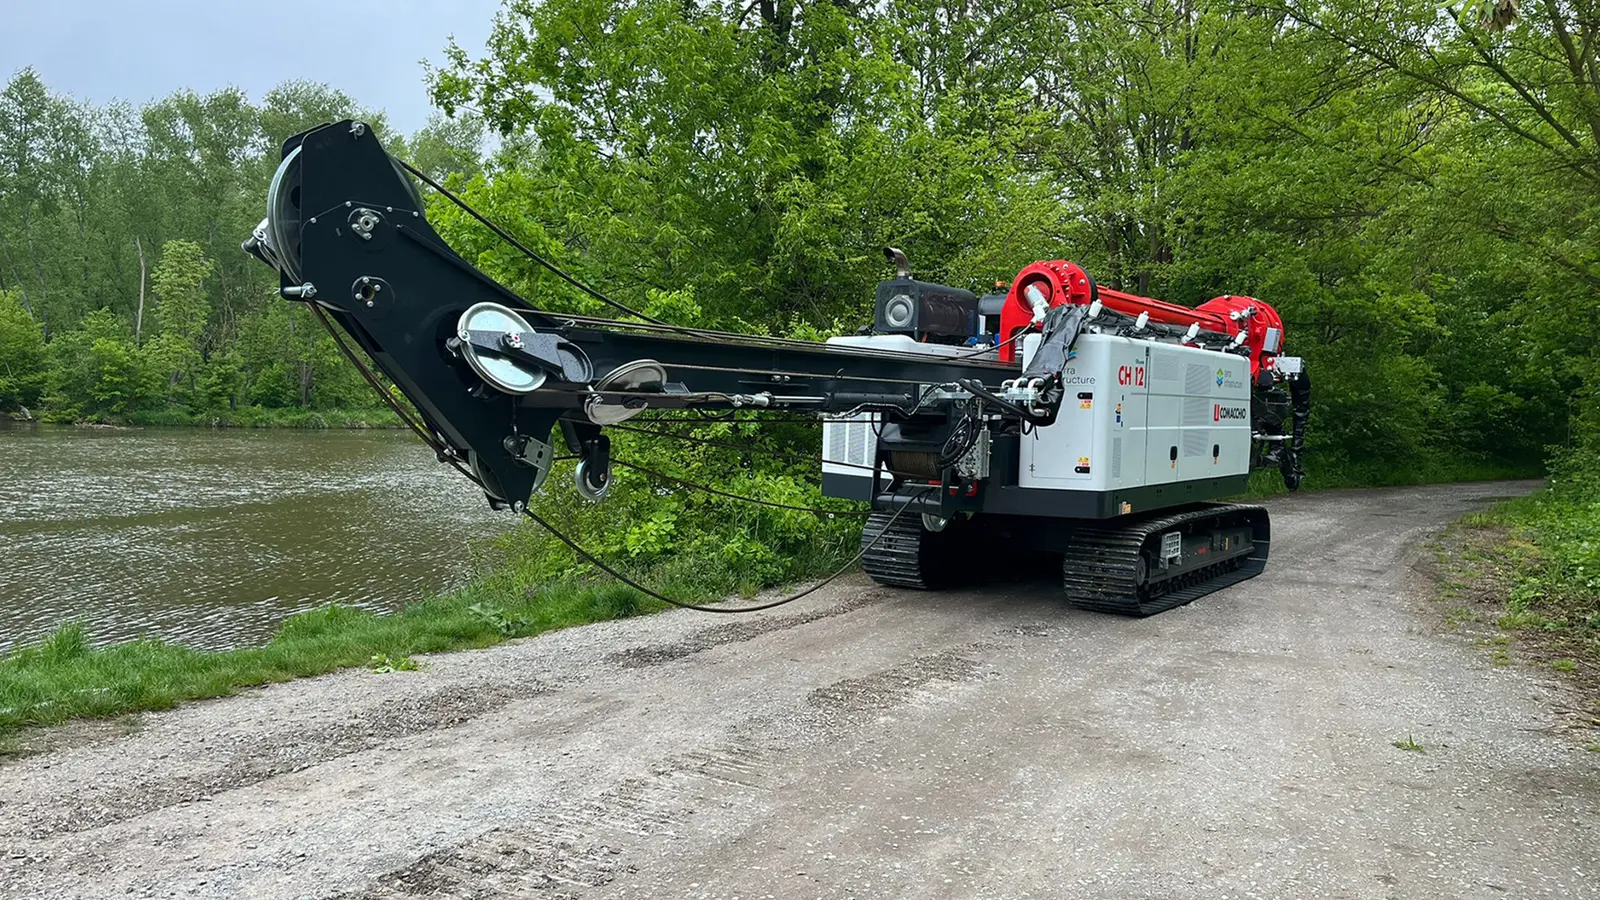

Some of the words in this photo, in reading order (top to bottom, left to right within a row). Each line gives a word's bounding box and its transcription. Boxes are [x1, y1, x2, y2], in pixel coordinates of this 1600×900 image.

[1063, 367, 1075, 375] rra
[1118, 365, 1132, 386] CH
[1134, 366, 1144, 386] 12
[1062, 376, 1095, 384] ructure
